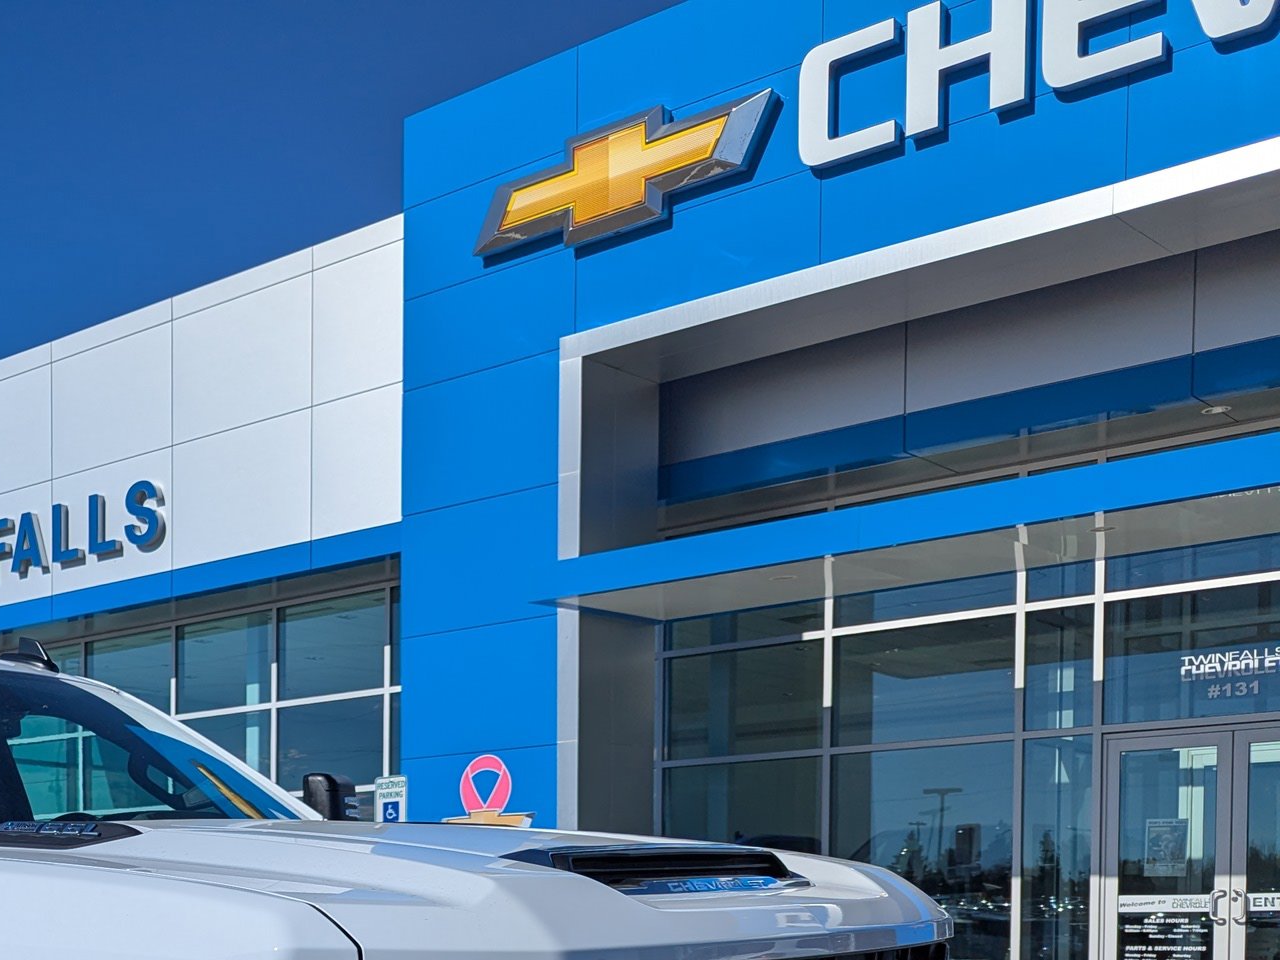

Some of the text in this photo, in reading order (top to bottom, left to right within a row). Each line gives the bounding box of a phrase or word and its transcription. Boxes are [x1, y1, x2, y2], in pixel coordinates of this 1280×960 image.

[1207, 680, 1259, 698] #131
[377, 781, 405, 790] RESERVED
[379, 790, 404, 799] PARKING
[667, 879, 765, 893] CHEVROLET
